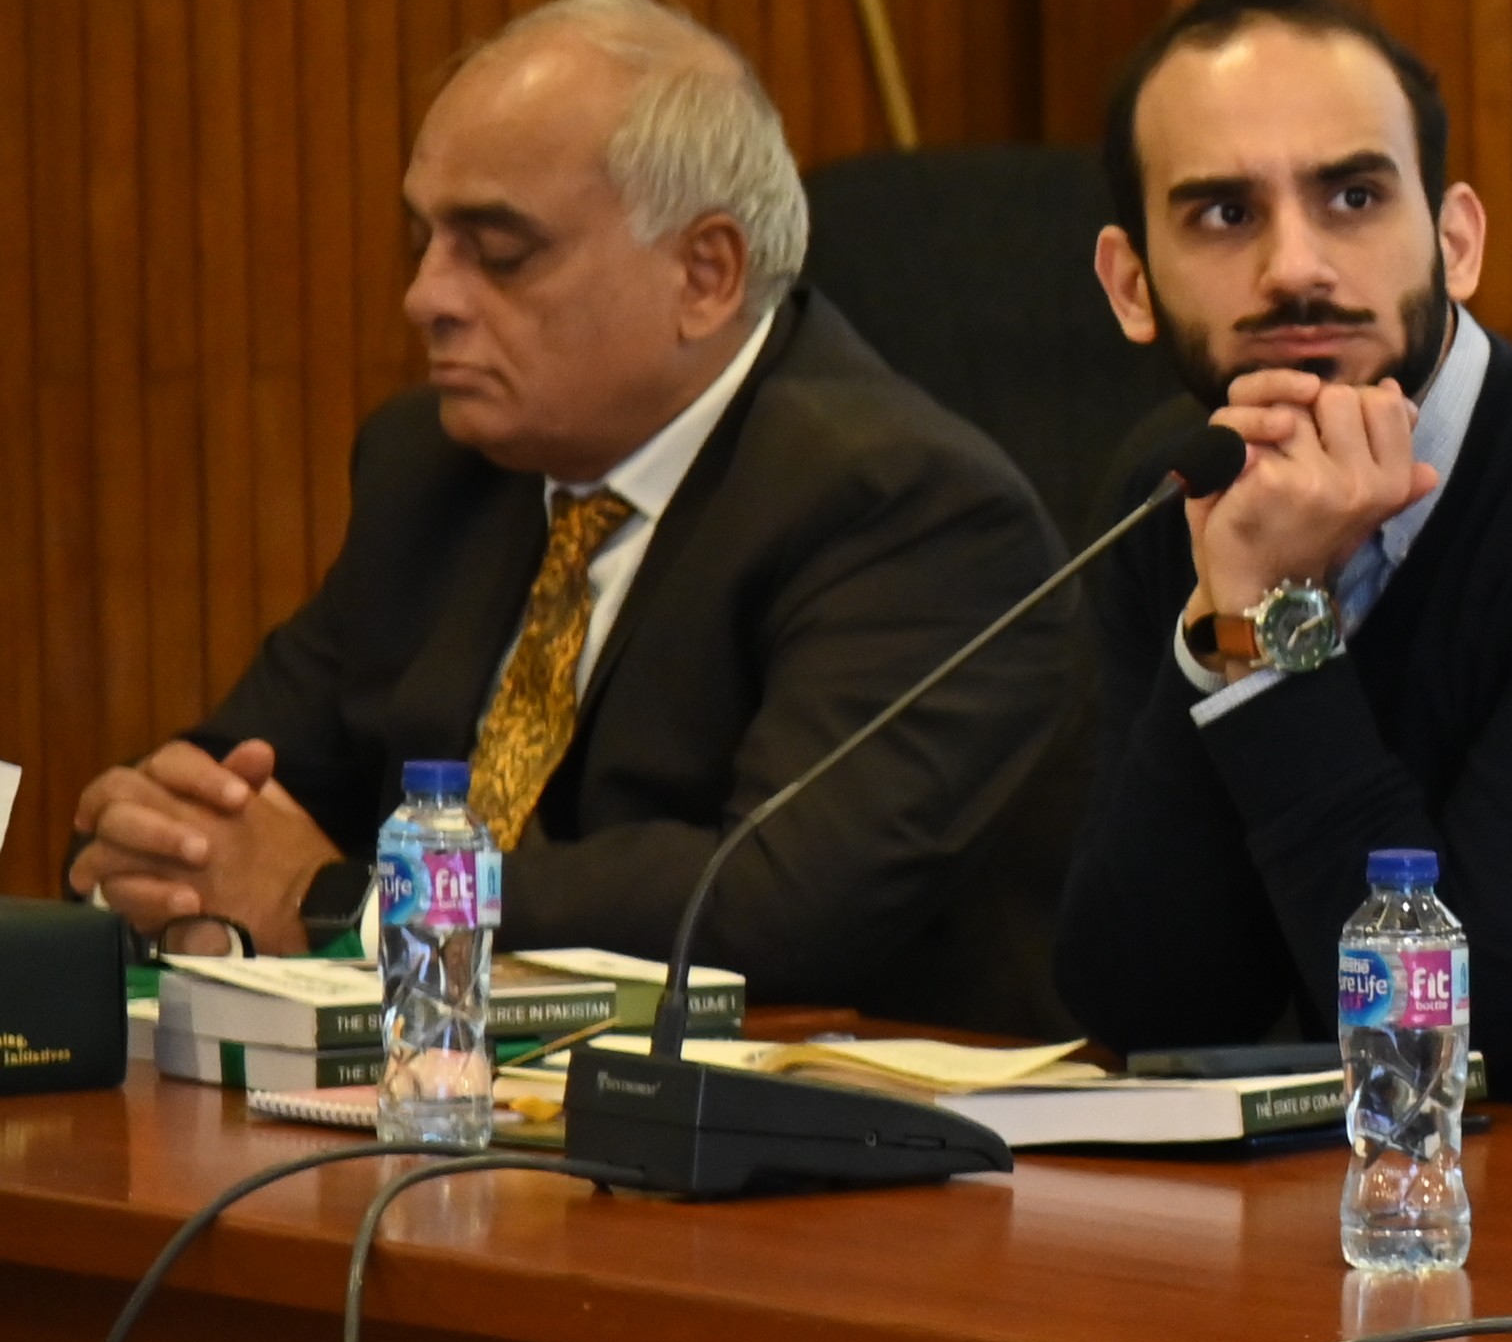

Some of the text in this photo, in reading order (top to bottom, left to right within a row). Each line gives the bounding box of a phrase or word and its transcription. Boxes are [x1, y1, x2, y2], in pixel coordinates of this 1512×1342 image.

[435, 867, 474, 900] fit
[1357, 975, 1388, 1003] Life
[1412, 966, 1450, 1000] fit
[529, 1004, 543, 1023] IN
[546, 1000, 610, 1022] PAKISTAN
[687, 995, 727, 1014] OLUME
[337, 1014, 363, 1033] THE
[1255, 1099, 1272, 1120] THE
[1273, 1095, 1298, 1118] STATE
